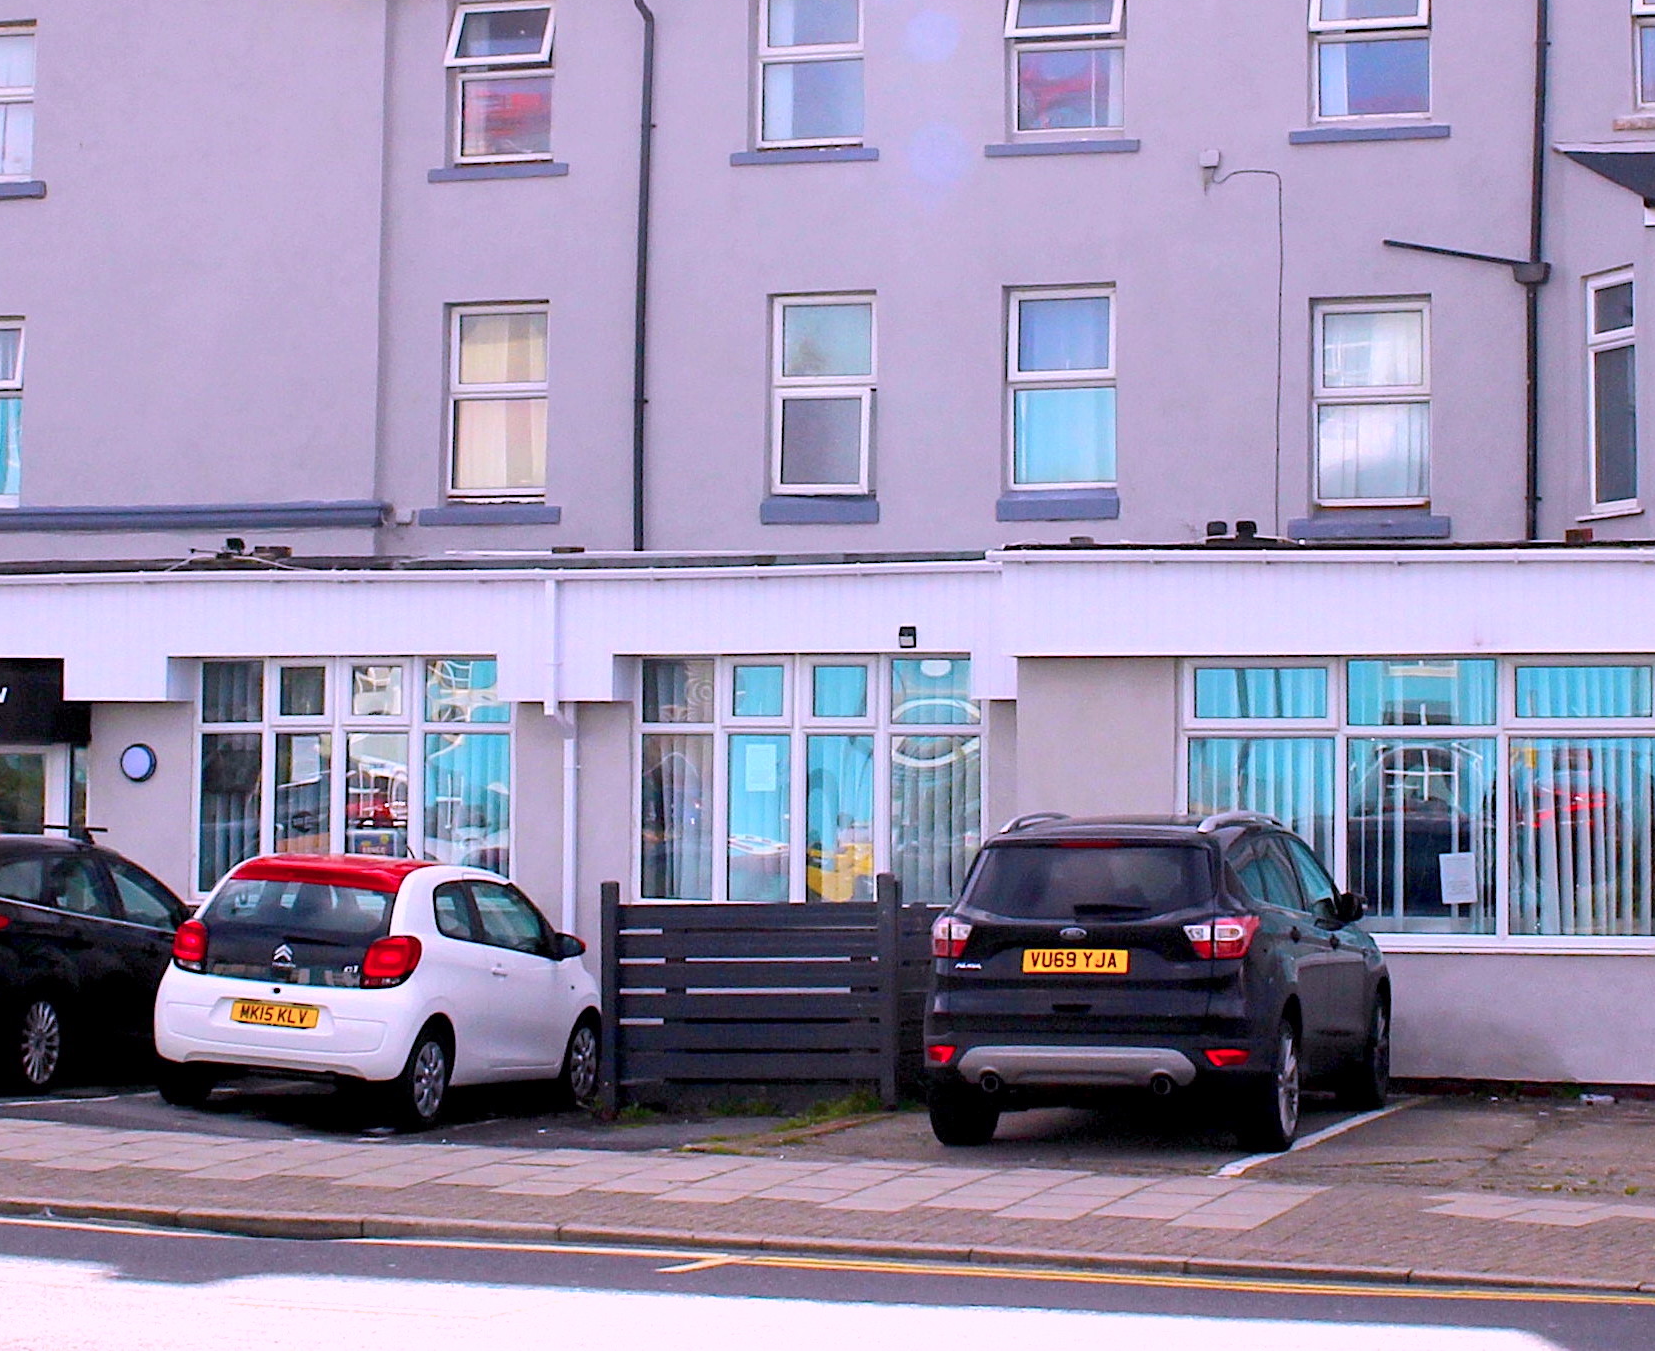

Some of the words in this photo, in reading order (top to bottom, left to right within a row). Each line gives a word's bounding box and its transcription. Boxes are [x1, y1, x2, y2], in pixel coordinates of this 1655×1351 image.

[1031, 952, 1077, 968] VU69
[1083, 952, 1117, 968] YJA
[239, 1003, 273, 1022] MK15
[277, 1005, 308, 1024] KLV
